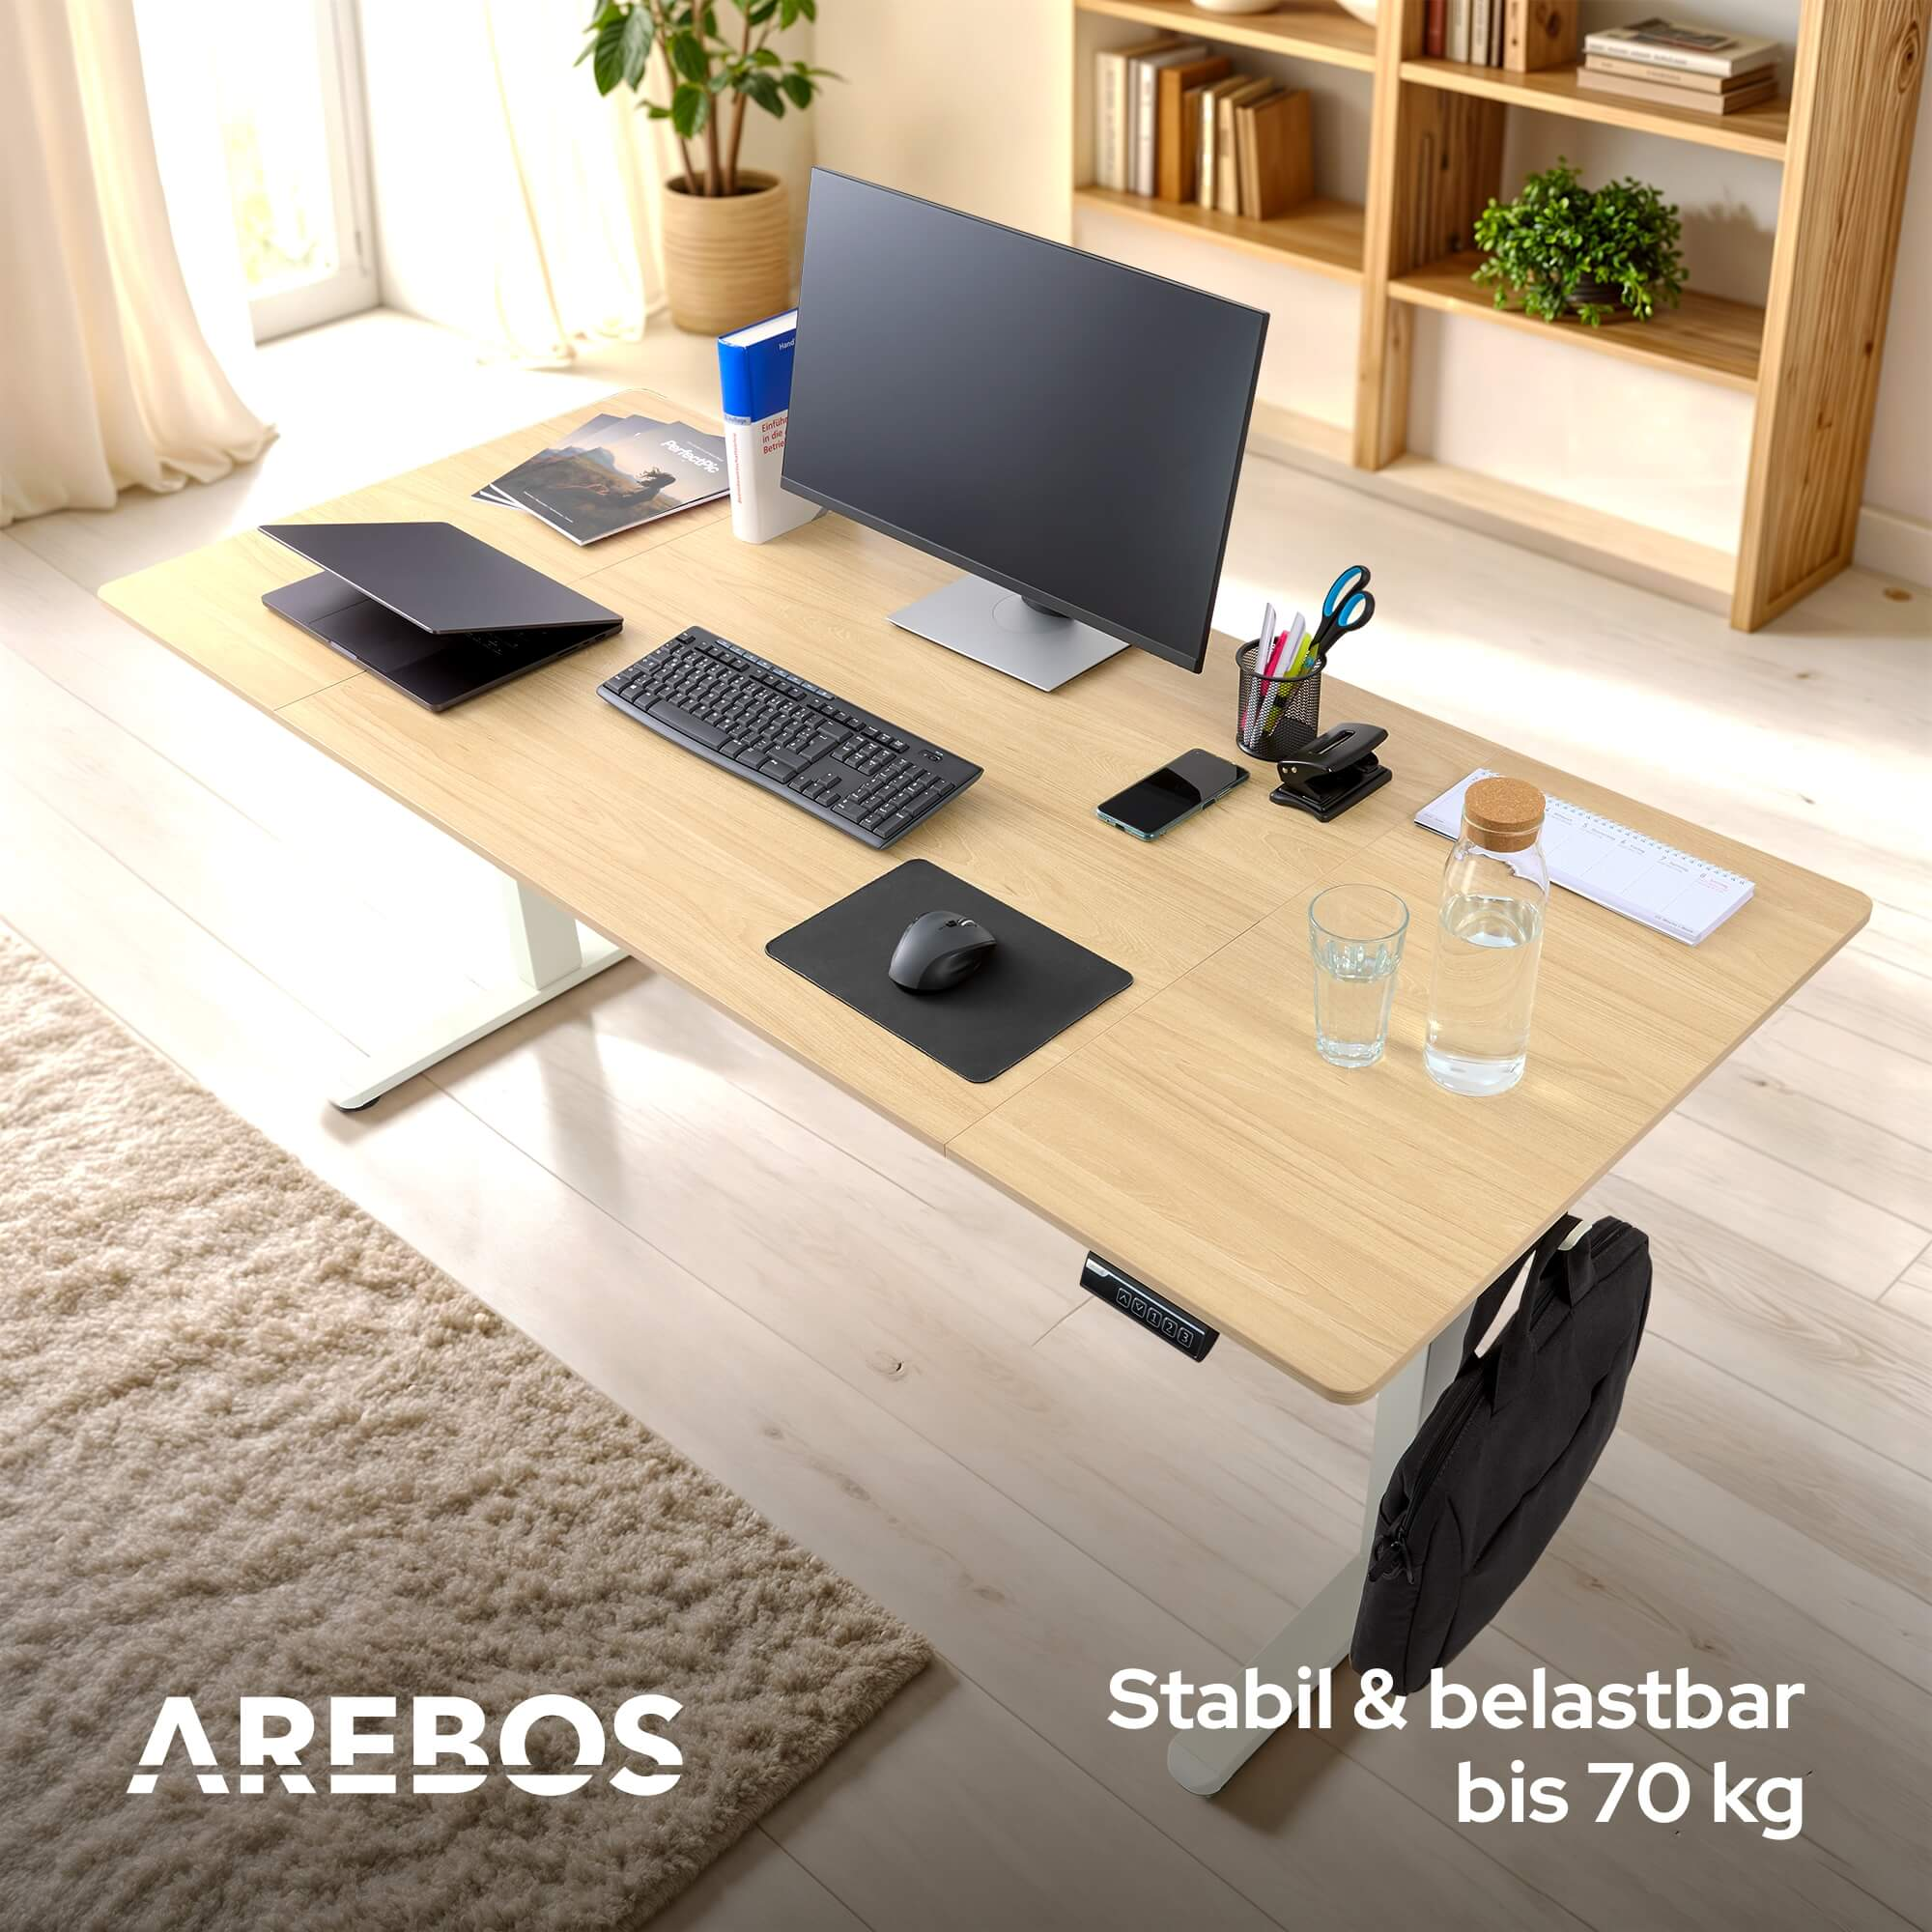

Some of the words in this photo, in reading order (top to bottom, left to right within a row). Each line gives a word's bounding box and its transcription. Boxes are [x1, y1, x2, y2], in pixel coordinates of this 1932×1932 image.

[762, 434, 770, 443] in
[771, 430, 783, 440] die
[763, 440, 785, 455] Betrie
[1166, 1321, 1173, 1333] 2
[1181, 1332, 1188, 1343] 3
